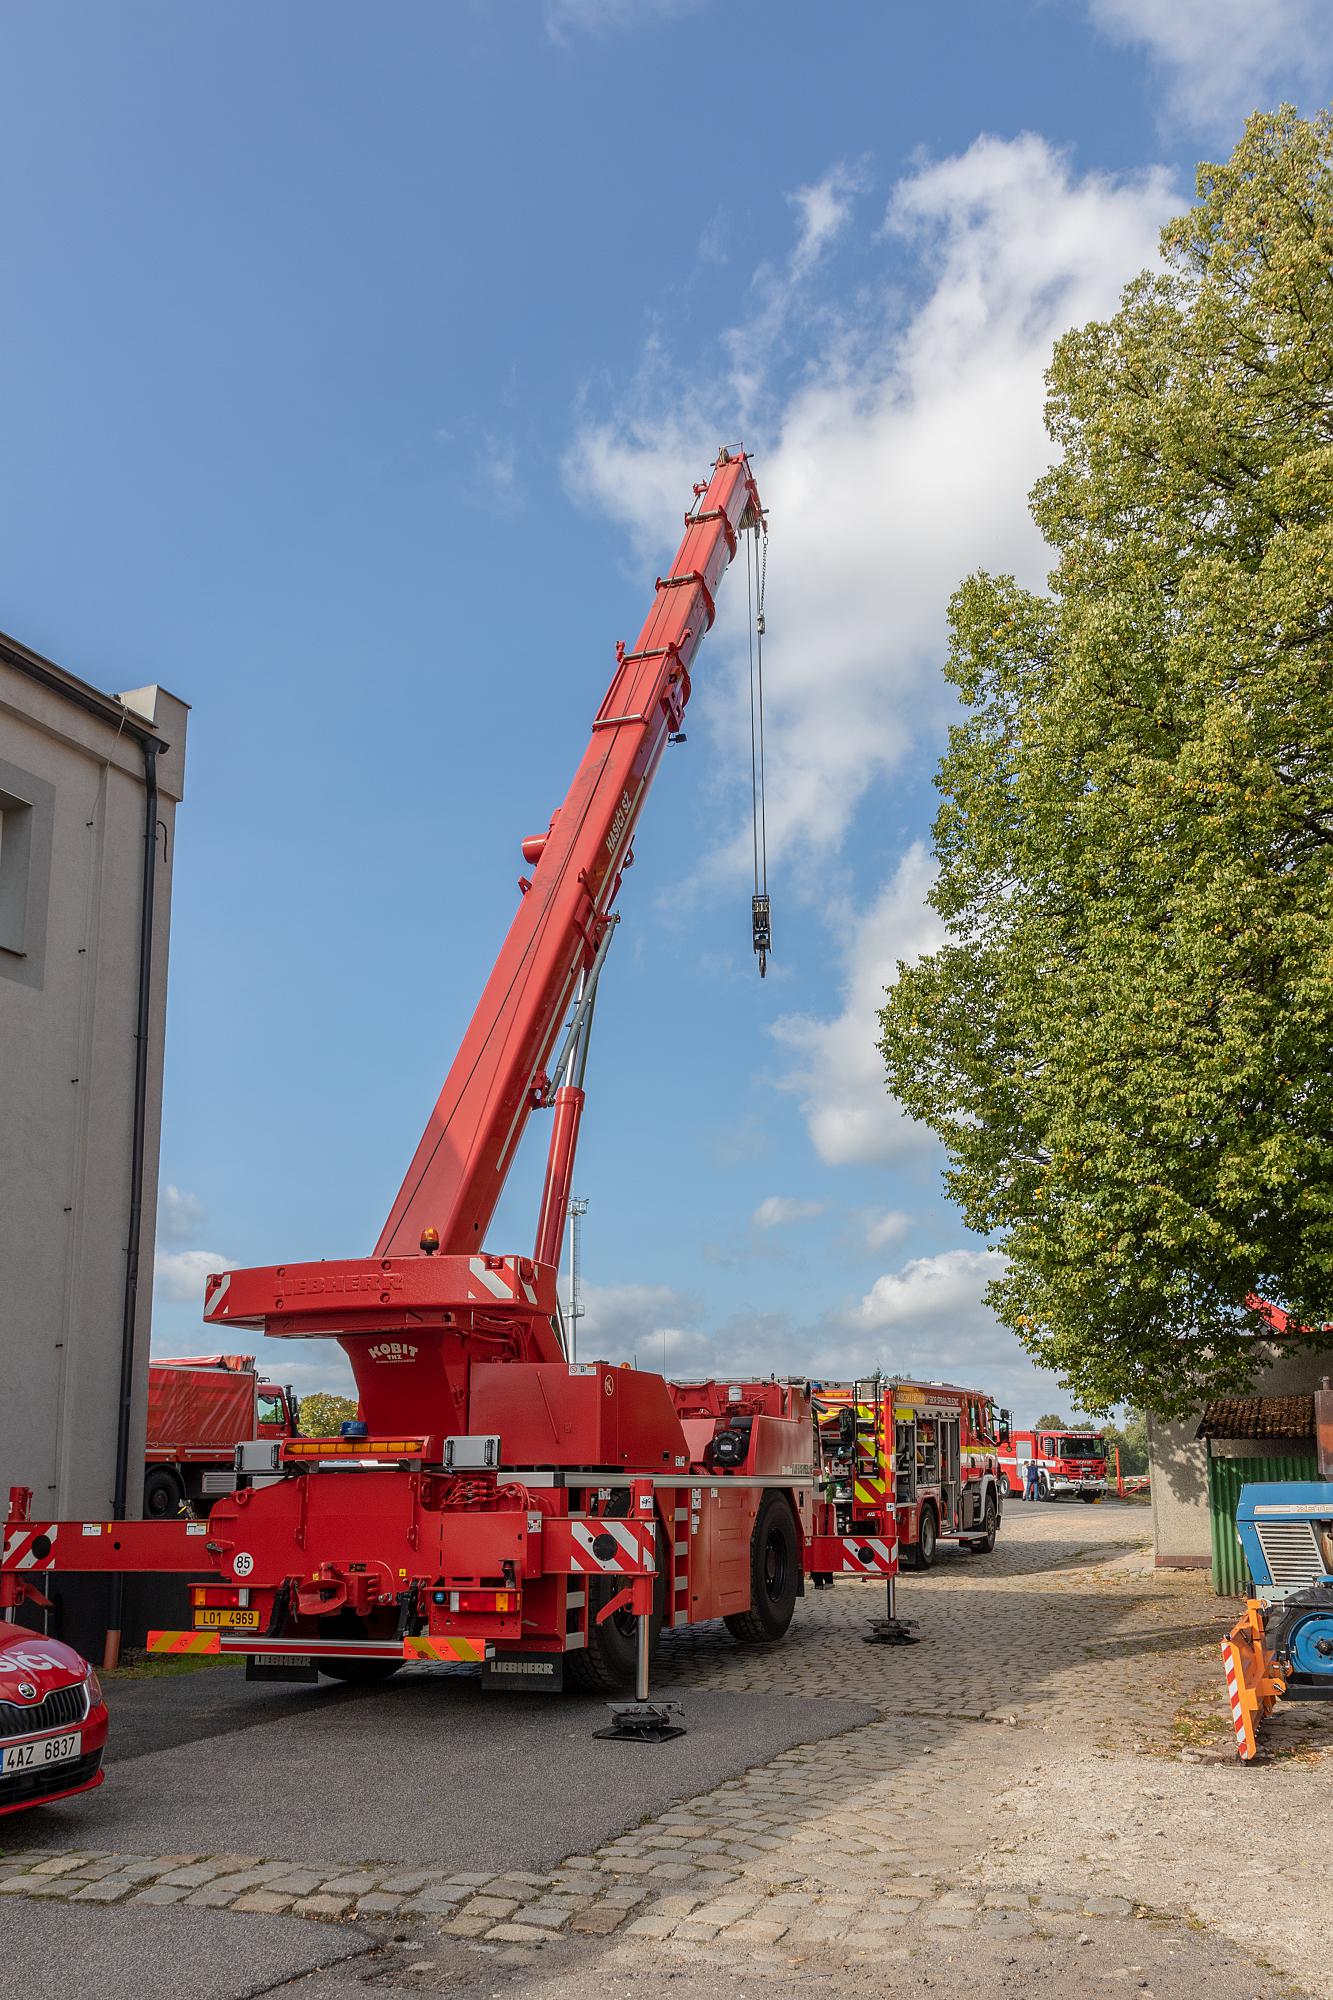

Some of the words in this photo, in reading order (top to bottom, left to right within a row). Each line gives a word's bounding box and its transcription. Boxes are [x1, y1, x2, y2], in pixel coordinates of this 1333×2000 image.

[273, 1273, 403, 1298] LIEBHERR
[368, 1343, 418, 1359] KOBIT
[236, 1556, 250, 1569] 85
[229, 1612, 254, 1625] 4969
[490, 1661, 554, 1675] LIEBHERR
[7, 1746, 34, 1768] 4AZ
[44, 1736, 75, 1760] 6837
